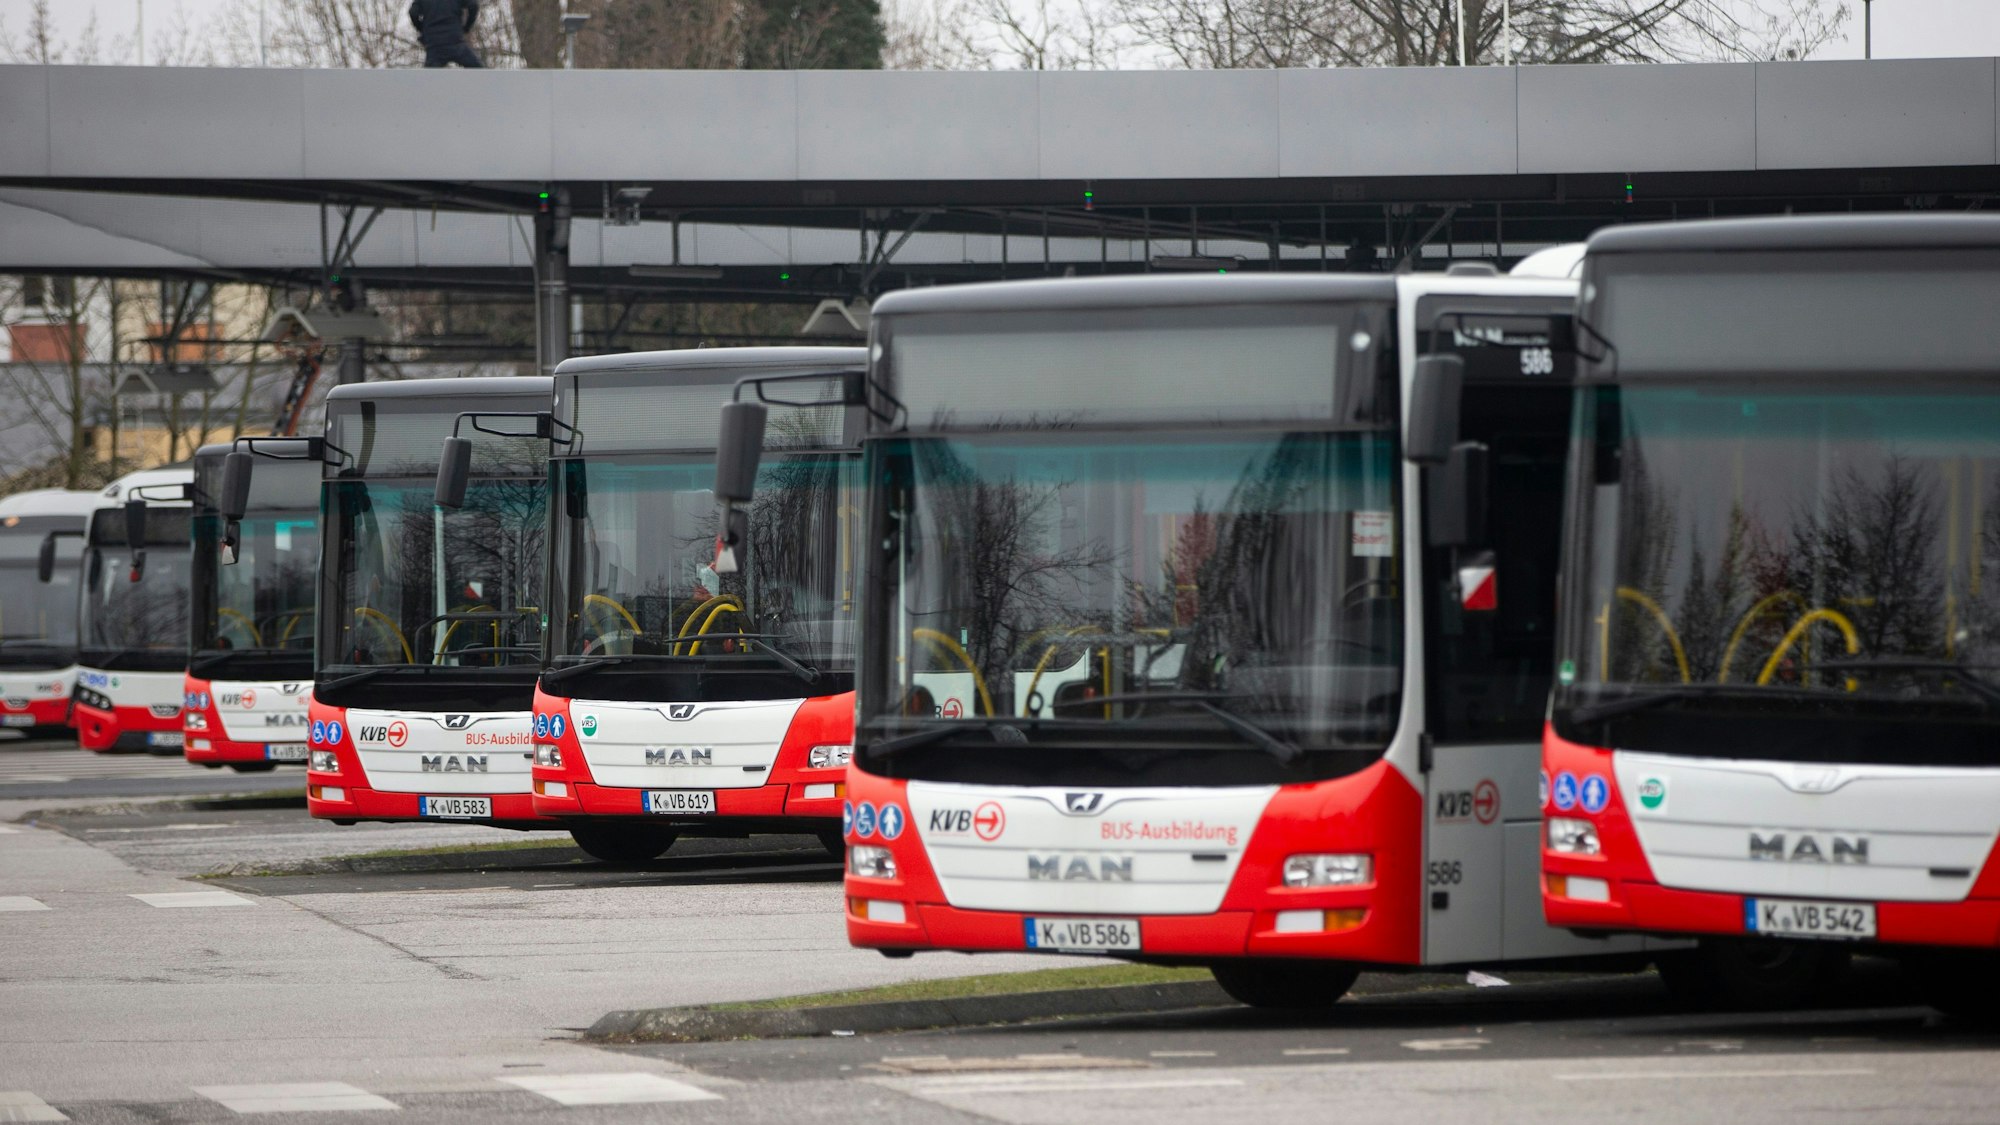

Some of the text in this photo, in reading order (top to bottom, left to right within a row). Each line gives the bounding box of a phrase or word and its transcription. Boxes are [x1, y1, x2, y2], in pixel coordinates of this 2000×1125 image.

[1521, 347, 1553, 374] 586
[360, 726, 387, 742] KVB
[582, 719, 594, 727] VRS
[421, 754, 488, 773] MAN
[645, 747, 713, 766] MAN
[1436, 791, 1472, 818] KVB
[929, 809, 1238, 845] KVB BUS-Ausbildung
[1749, 832, 1869, 864] MAN
[1027, 854, 1135, 882] MAN
[1428, 860, 1462, 886] 586
